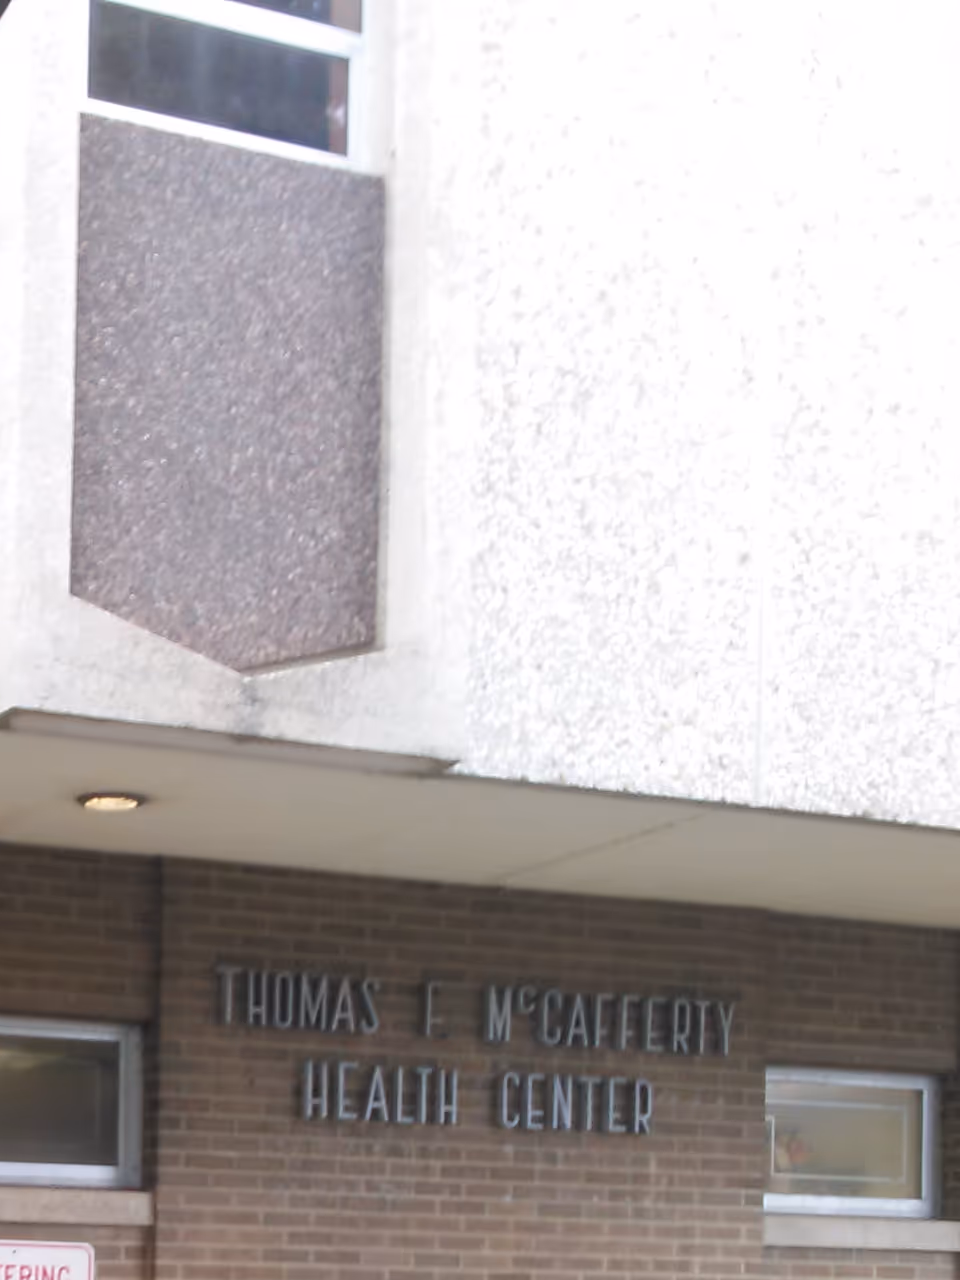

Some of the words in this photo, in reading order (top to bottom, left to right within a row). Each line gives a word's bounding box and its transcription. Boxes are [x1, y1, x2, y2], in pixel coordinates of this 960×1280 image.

[216, 965, 381, 1035] THOMAS
[302, 1058, 459, 1126] HEALTH
[500, 1070, 654, 1136] CENTER
